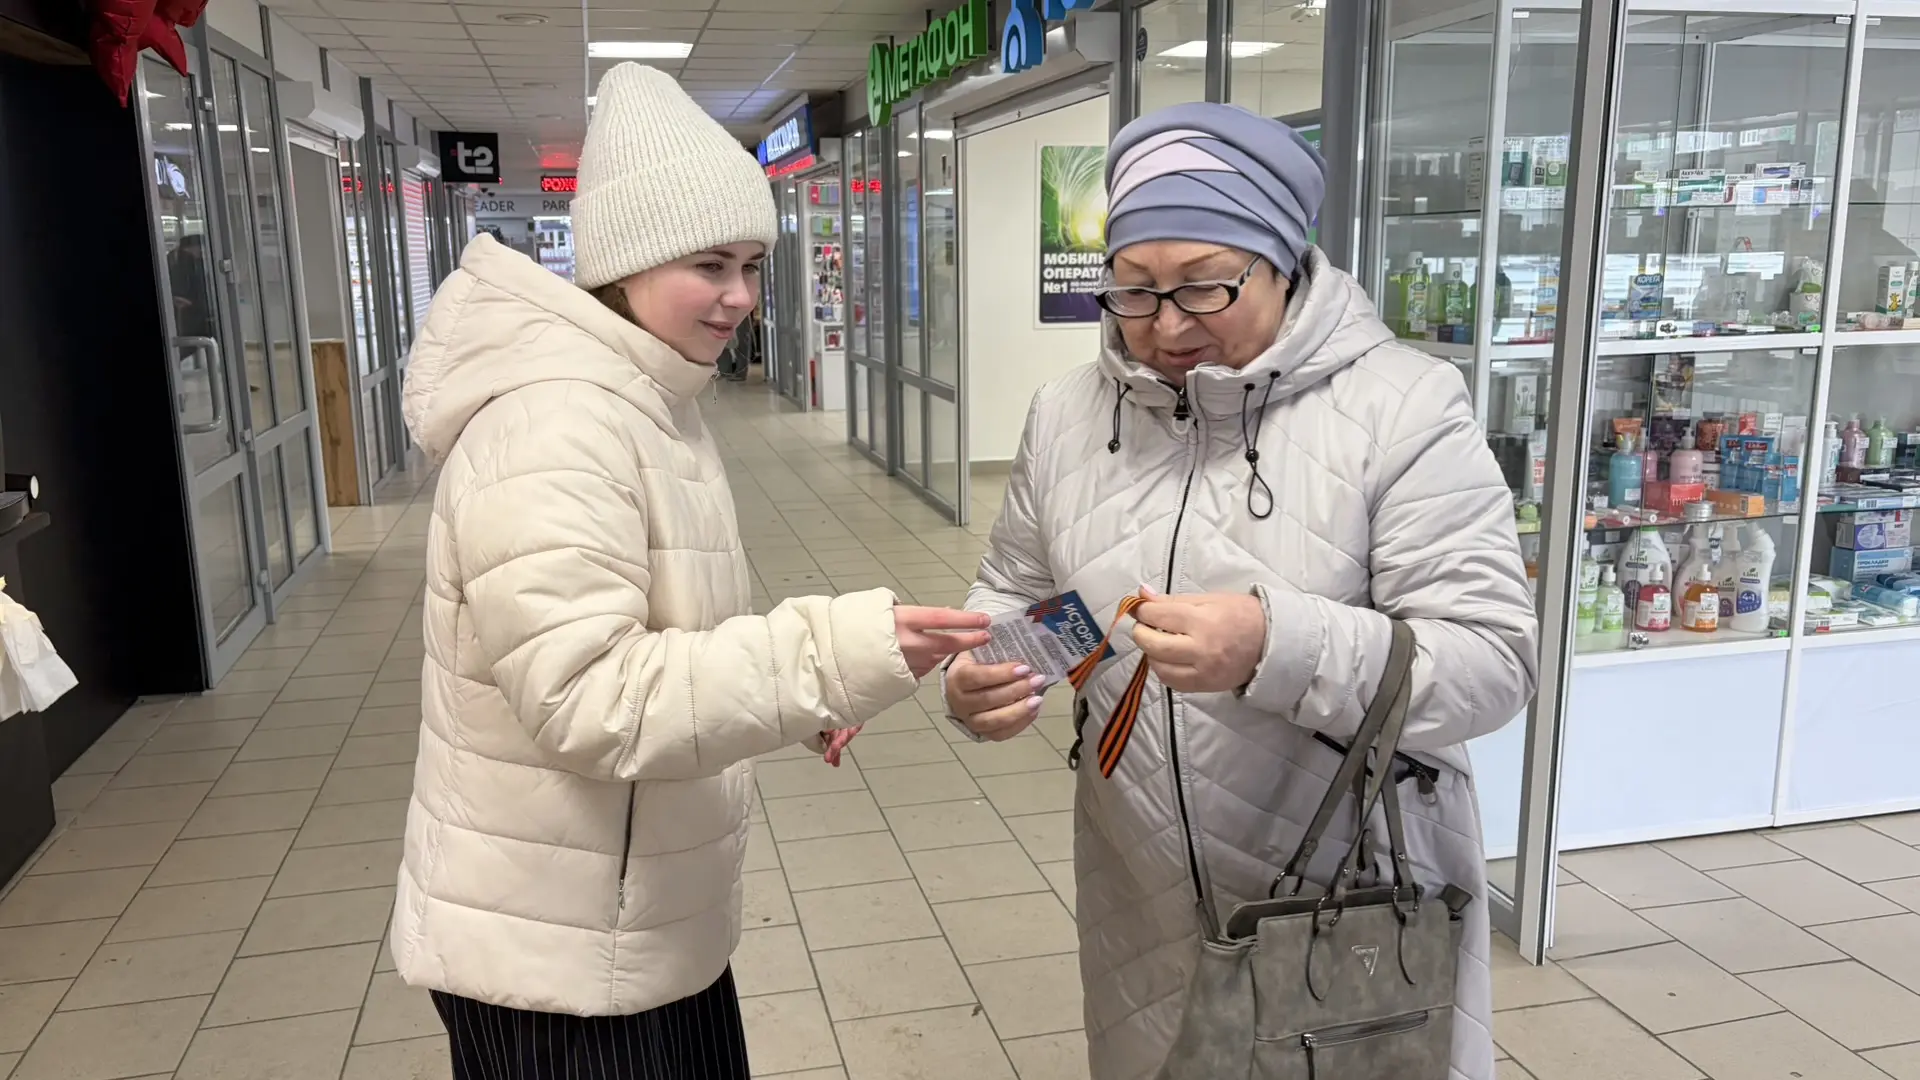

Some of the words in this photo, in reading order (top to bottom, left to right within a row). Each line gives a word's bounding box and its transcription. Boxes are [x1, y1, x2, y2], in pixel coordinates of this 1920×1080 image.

[884, 0, 975, 104] МЕГАФОН
[453, 141, 494, 174] t2
[1043, 281, 1068, 294] №1
